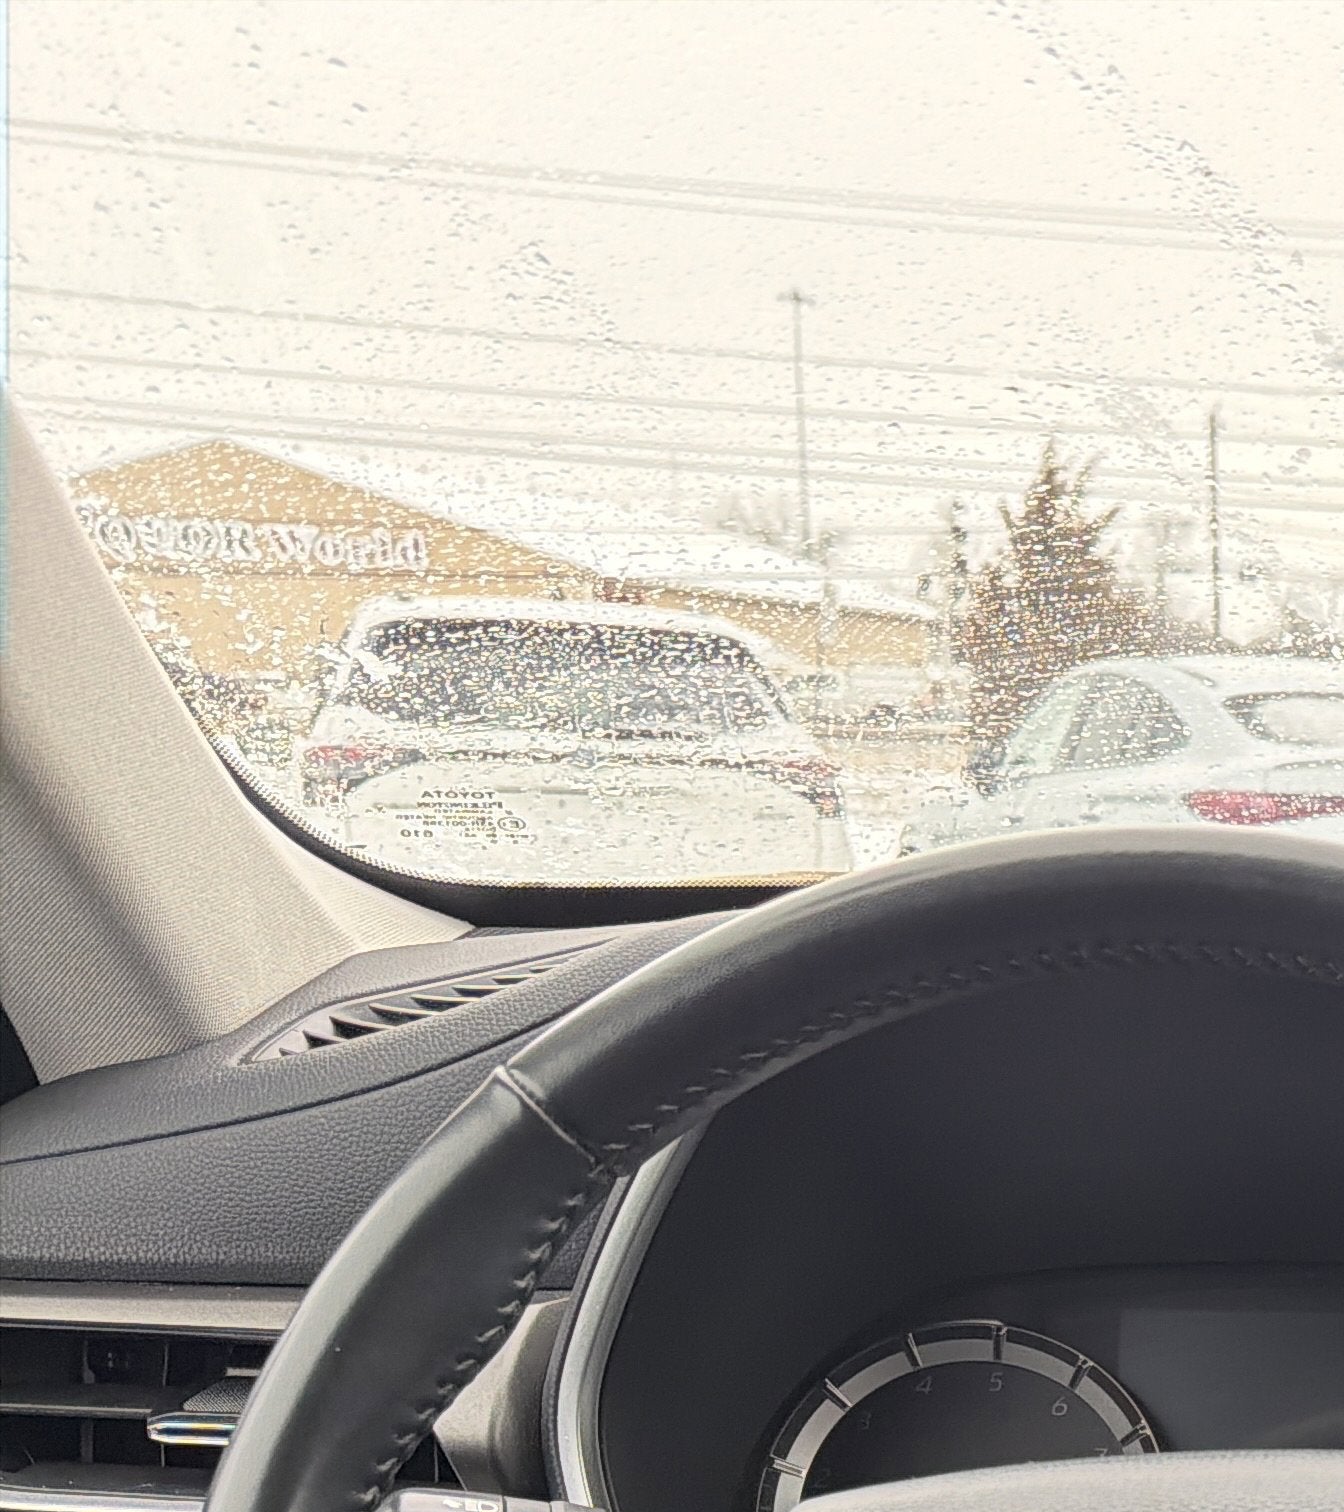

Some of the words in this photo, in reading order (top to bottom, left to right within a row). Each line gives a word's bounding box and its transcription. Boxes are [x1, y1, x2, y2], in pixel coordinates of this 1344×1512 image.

[915, 1375, 933, 1395] 4
[988, 1371, 1003, 1392] 5
[1051, 1396, 1068, 1417] 6
